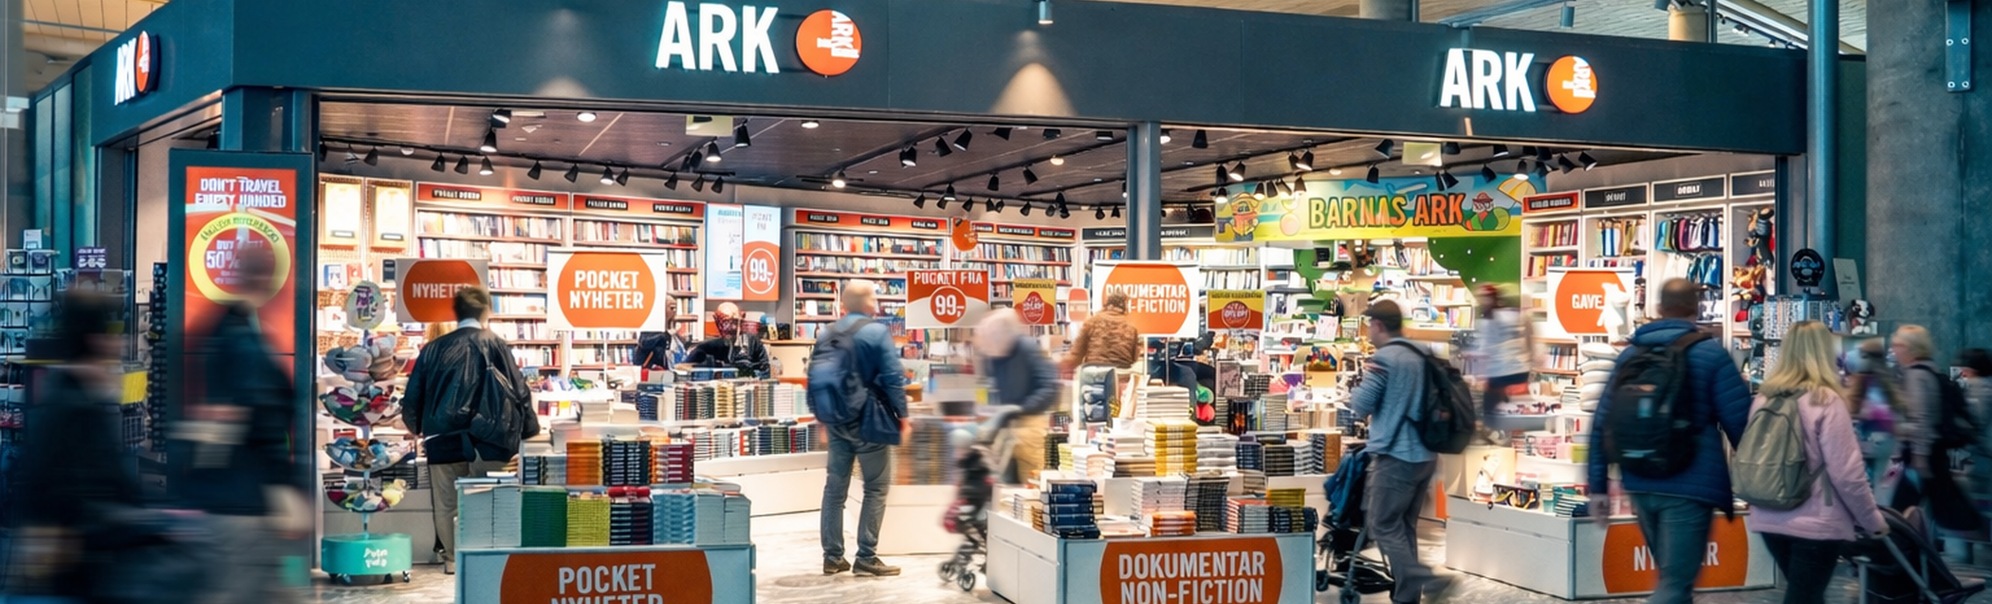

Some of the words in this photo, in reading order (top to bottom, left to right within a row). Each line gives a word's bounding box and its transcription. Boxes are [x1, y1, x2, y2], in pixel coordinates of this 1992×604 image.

[655, 1, 780, 73] ARK
[1439, 48, 1536, 112] ARK
[1309, 196, 1407, 229] BARNAS
[1413, 193, 1466, 226] ARK
[575, 270, 640, 289] POCKET
[569, 290, 644, 309] NYHETER
[559, 563, 656, 594] POCKET
[1119, 551, 1265, 579] DOKUMENTAR
[1121, 577, 1263, 604] NON-FICTION
